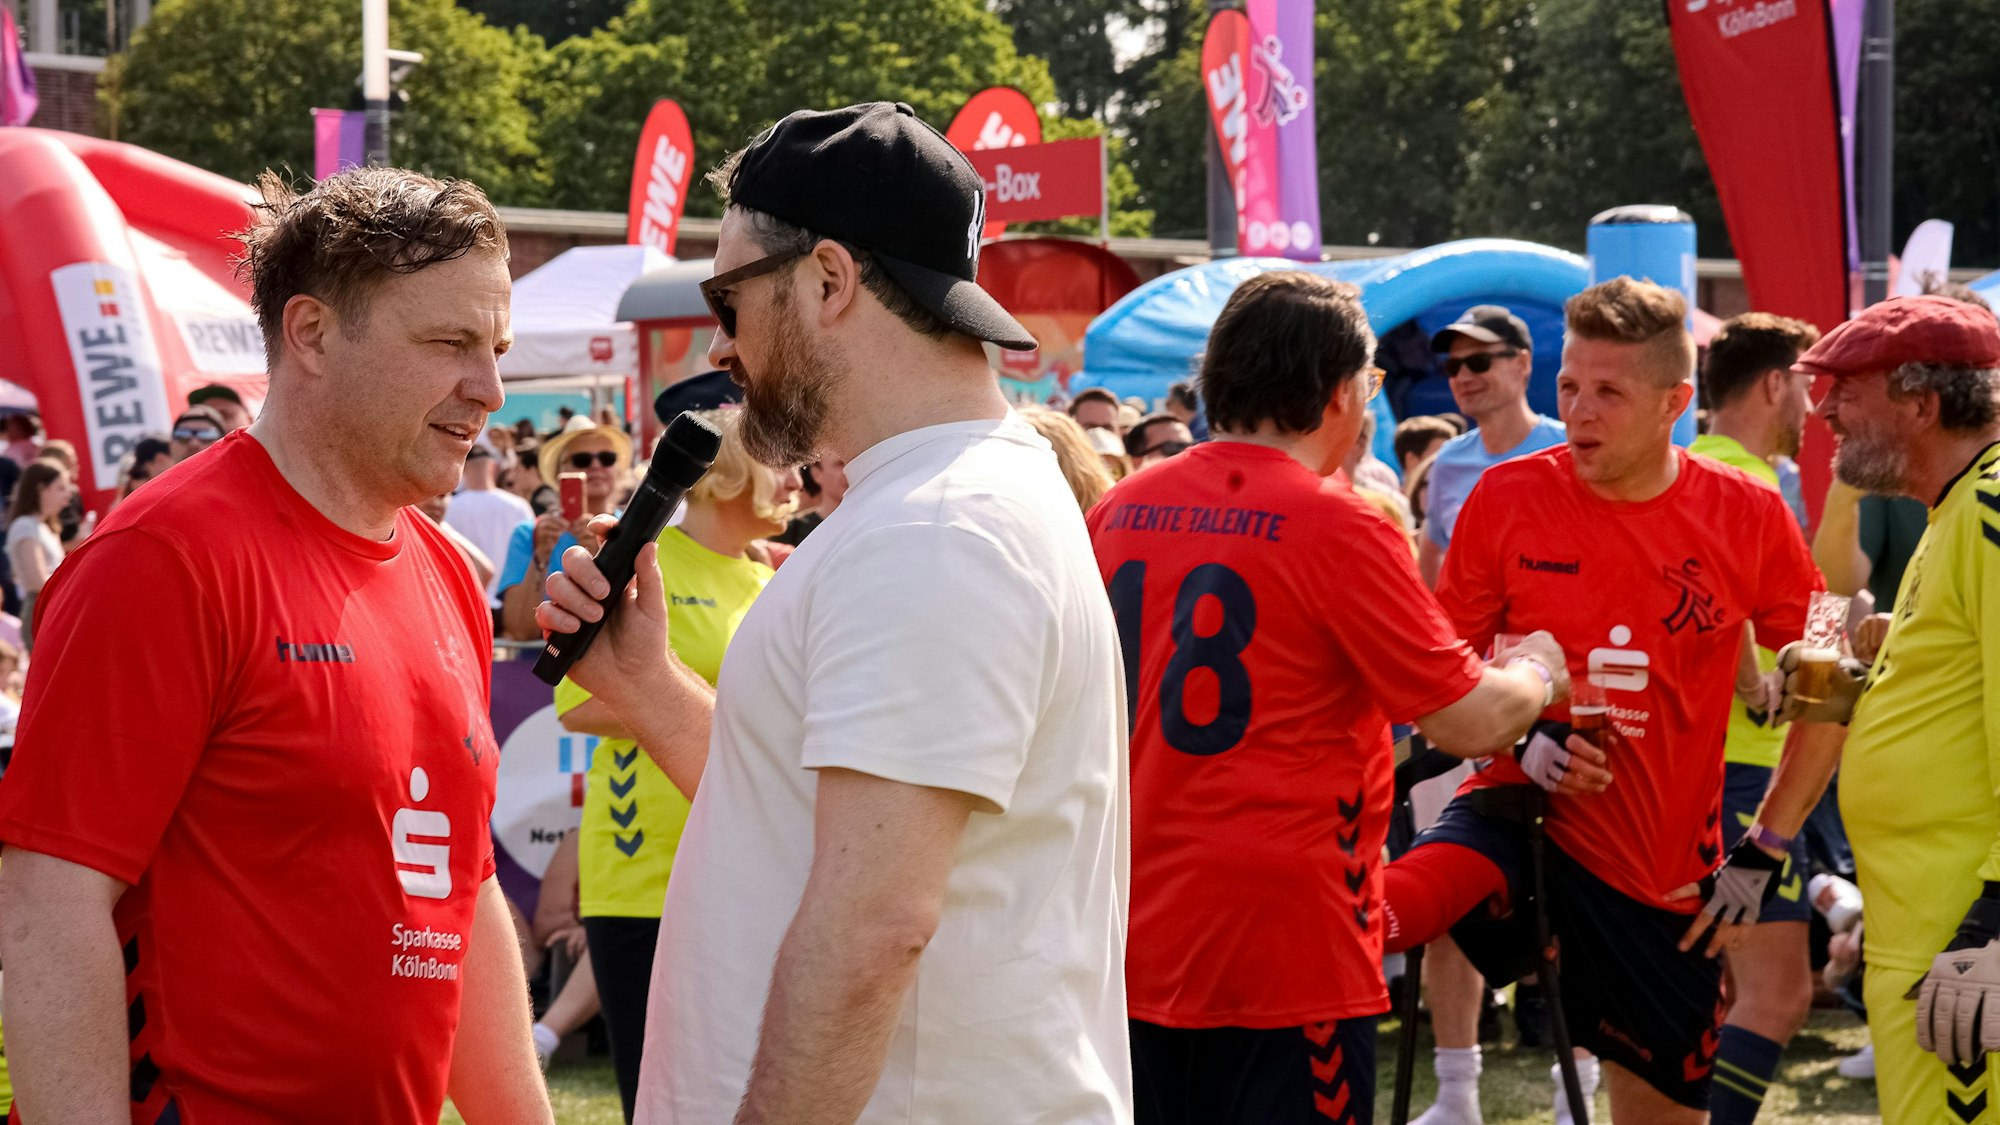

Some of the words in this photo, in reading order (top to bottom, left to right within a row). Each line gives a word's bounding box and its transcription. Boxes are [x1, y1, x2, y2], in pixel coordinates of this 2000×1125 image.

[981, 164, 1041, 203] -Box
[78, 324, 147, 467] REWE
[1105, 502, 1184, 533] ATENTE
[1188, 506, 1286, 542] TALENTE
[1519, 554, 1580, 575] hummel
[1109, 559, 1257, 757] 18
[391, 923, 462, 951] Sparkasse
[391, 953, 458, 982] KölnBonn
